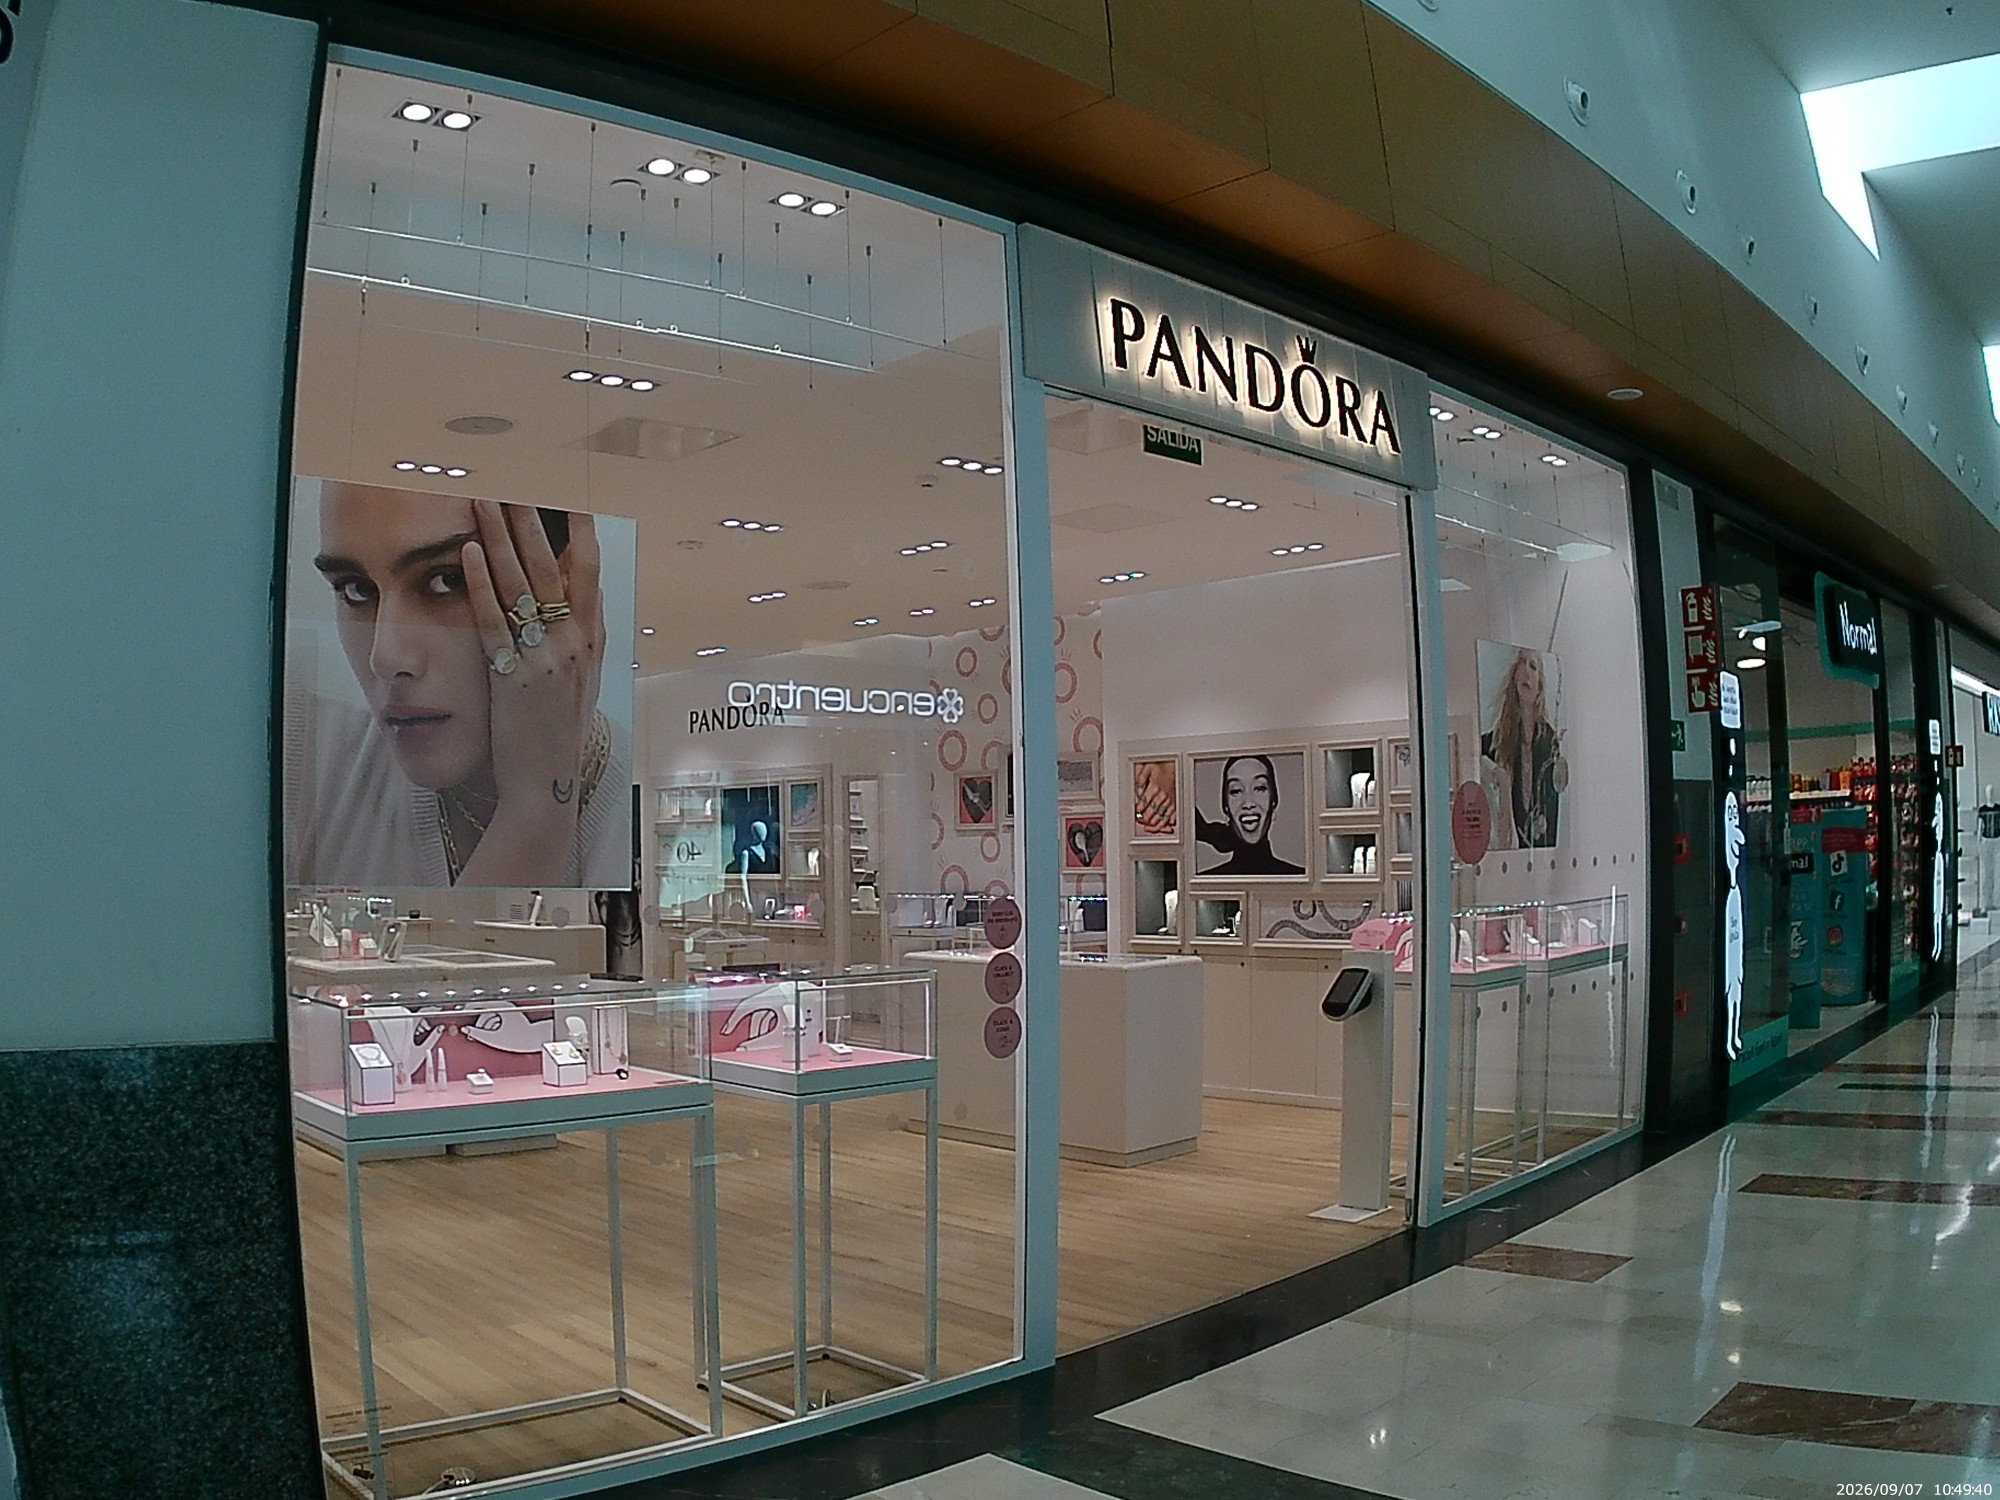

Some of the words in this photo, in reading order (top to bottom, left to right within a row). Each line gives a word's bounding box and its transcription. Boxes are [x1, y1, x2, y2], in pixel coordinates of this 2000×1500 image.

[1108, 297, 1402, 455] PANDORA
[1147, 425, 1199, 453] SALIDA
[1838, 600, 1878, 656] Normal
[688, 701, 786, 735] PANDORA
